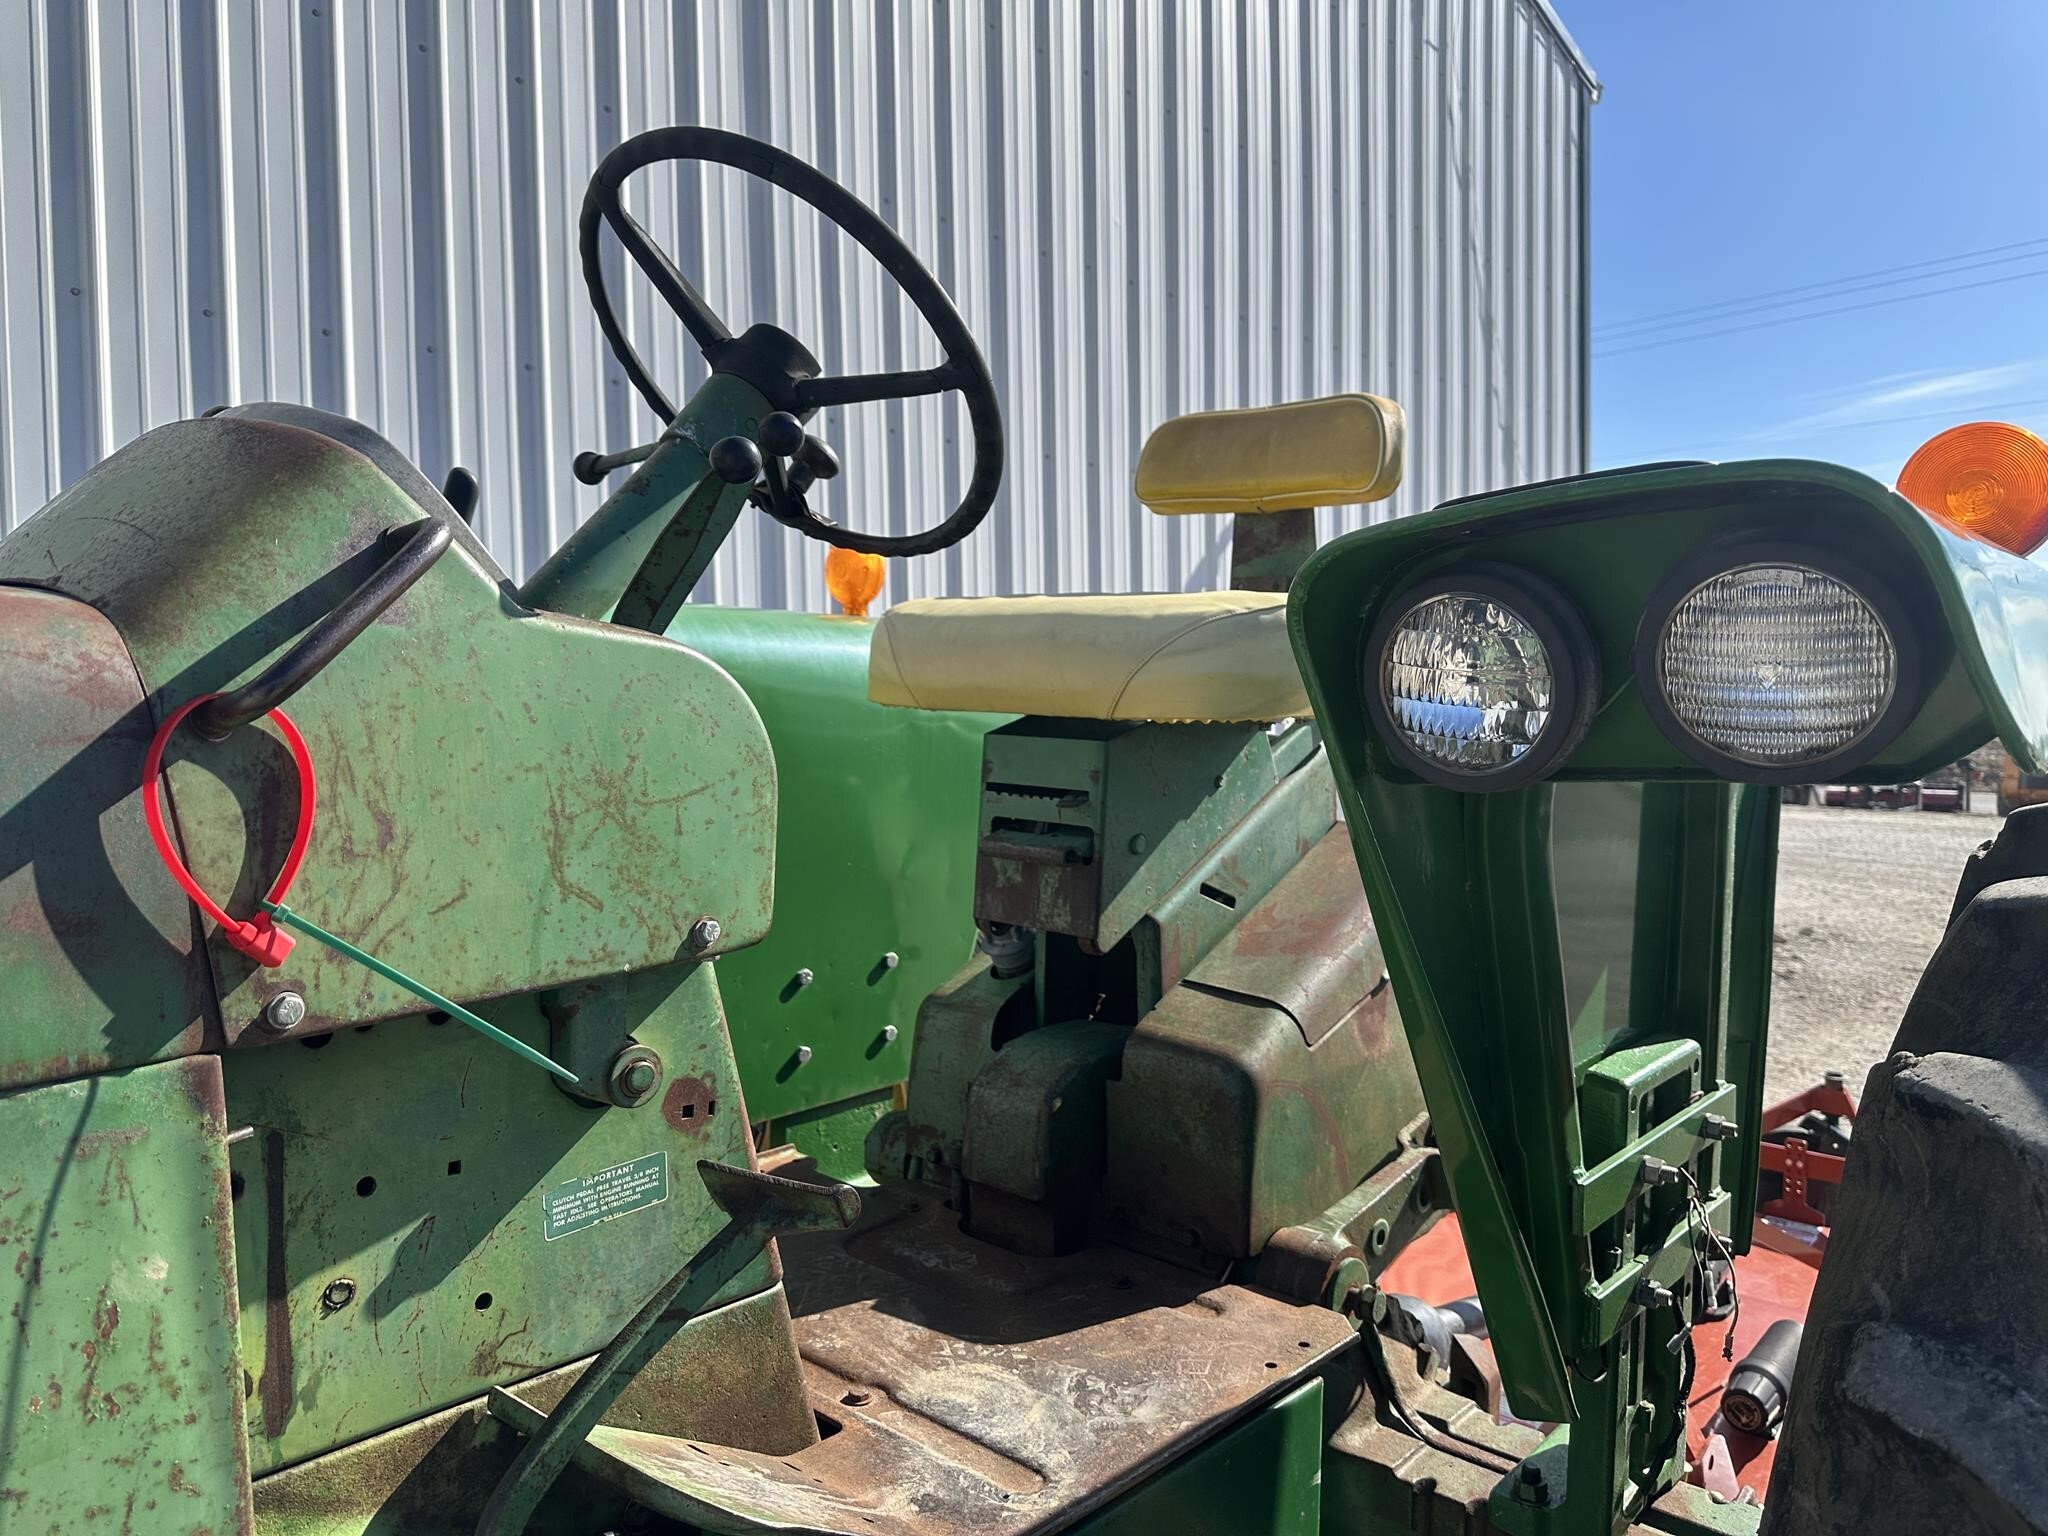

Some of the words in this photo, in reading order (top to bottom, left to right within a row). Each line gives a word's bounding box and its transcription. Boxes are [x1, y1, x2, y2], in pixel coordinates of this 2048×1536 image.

[552, 1194, 575, 1207] CLUTCH
[576, 1188, 595, 1199] PEDAL
[596, 1183, 610, 1192] FREE
[611, 1176, 632, 1187] TRAVEL
[645, 1166, 660, 1175] INCH
[552, 1200, 582, 1214] MINIMUM
[583, 1194, 599, 1204] WITH
[600, 1186, 622, 1198] ENGINE
[623, 1178, 650, 1190] RUNNING
[651, 1172, 660, 1180] AT
[582, 1164, 635, 1187] IMPORTANT
[553, 1211, 567, 1221] FAST
[635, 1180, 660, 1192] MANUAL
[553, 1218, 566, 1229] FOR
[566, 1207, 600, 1223] ADJUSTING
